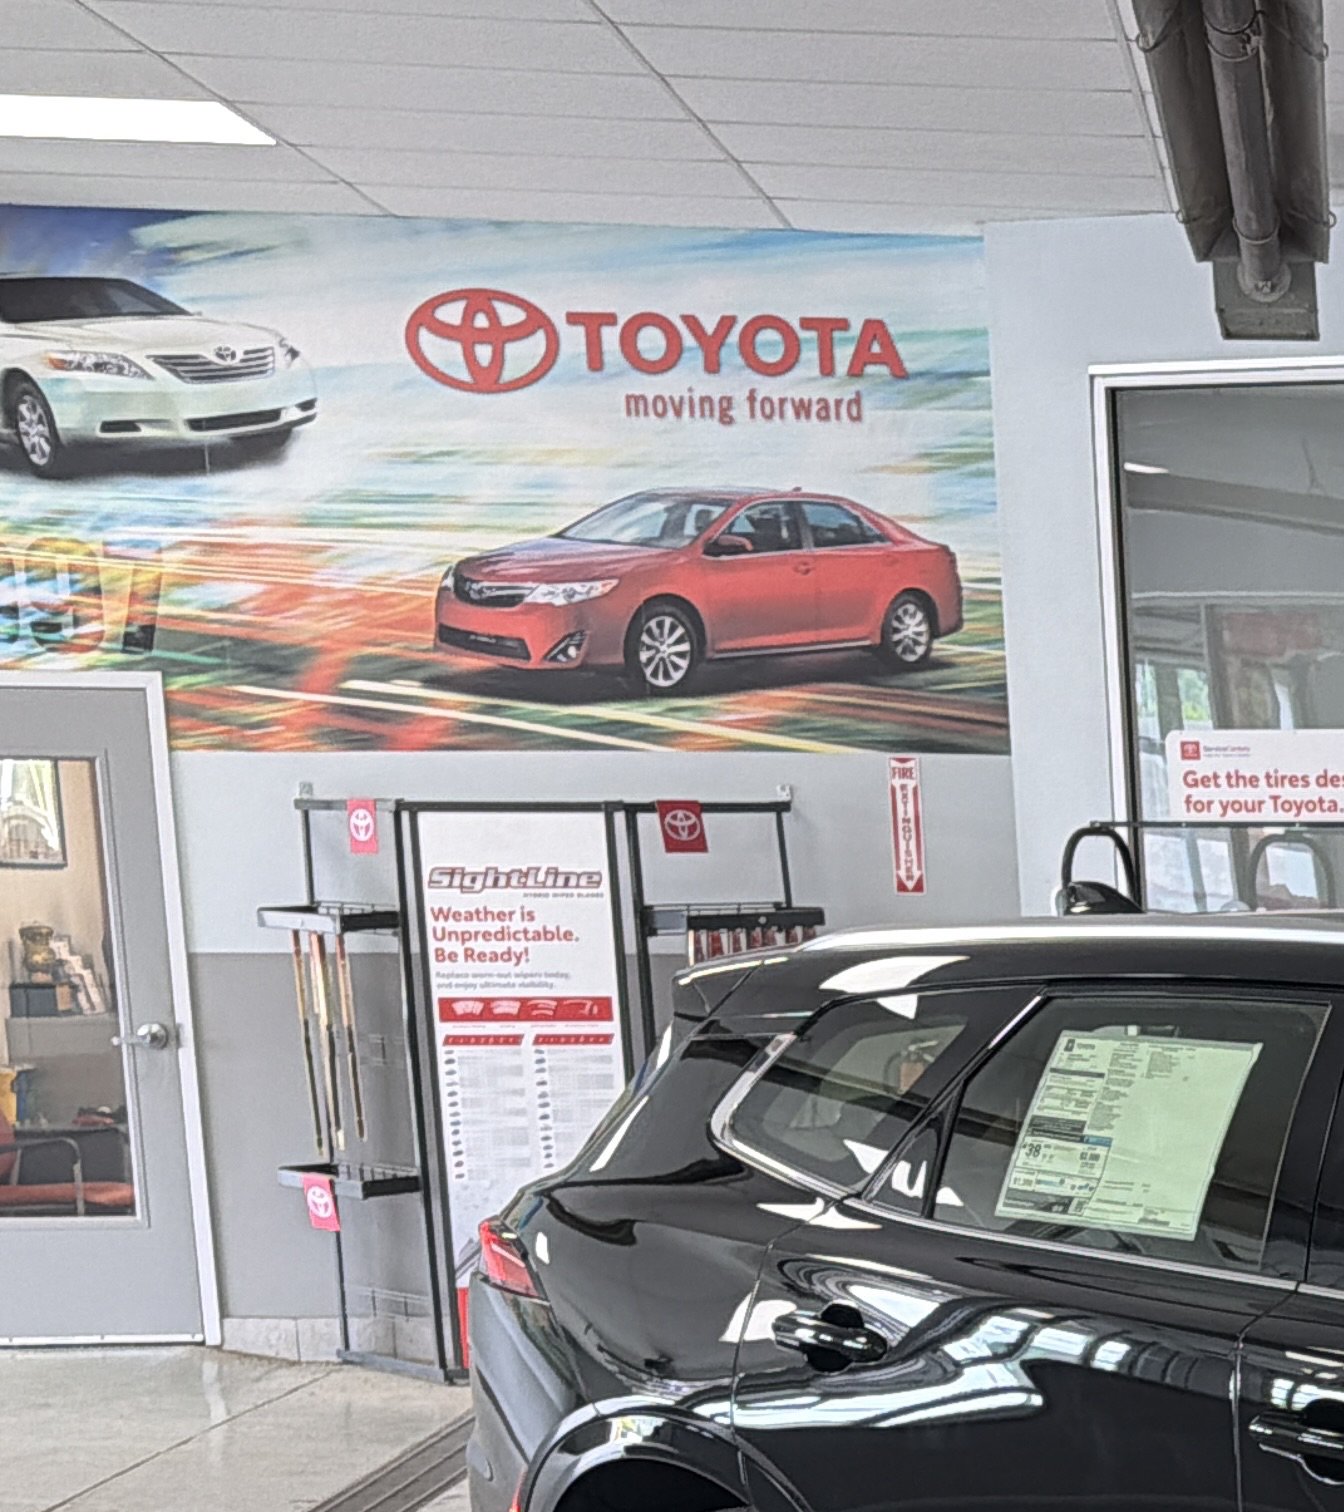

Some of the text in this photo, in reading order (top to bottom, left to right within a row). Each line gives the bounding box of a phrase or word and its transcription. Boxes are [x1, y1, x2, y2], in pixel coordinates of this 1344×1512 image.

[566, 311, 909, 380] TOYOTA
[624, 386, 863, 425] moving forward
[891, 766, 914, 779] FIRE
[1182, 770, 1222, 788] Get
[1226, 770, 1260, 788] the
[1265, 768, 1310, 788] tires
[1184, 794, 1344, 817] for your Toyota.
[428, 866, 603, 894] SightLine
[430, 905, 536, 922] Weather is
[432, 925, 580, 945] Unpredictable.
[434, 946, 530, 966] Be Ready!
